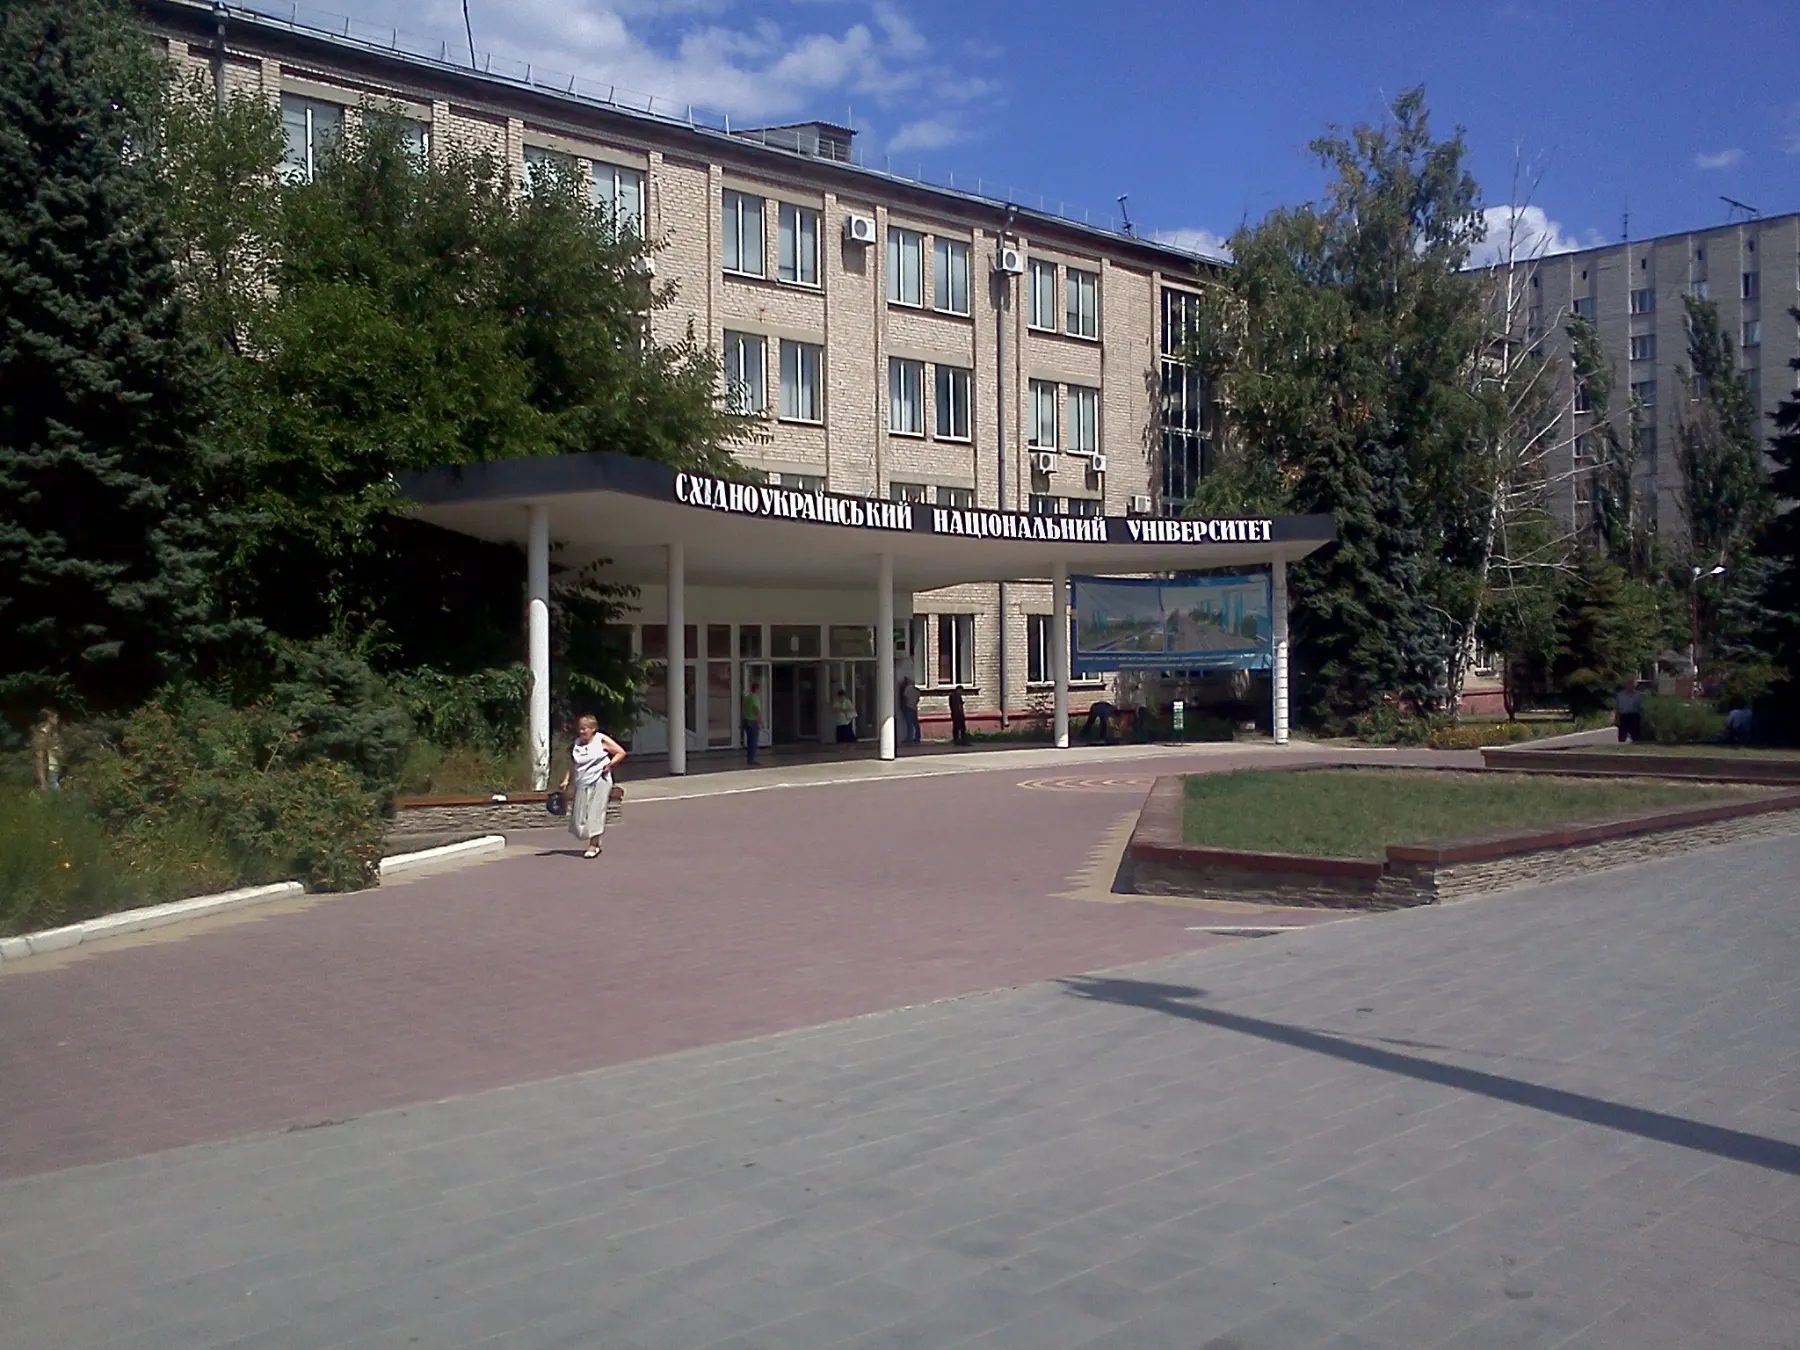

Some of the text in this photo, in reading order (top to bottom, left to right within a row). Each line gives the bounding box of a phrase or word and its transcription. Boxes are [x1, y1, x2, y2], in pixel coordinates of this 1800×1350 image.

[675, 473, 1273, 542] СХІДНОУКРАЇНСЬКИЙ НАЦІОНАЛЬНИЙ УНІВЕРСИТЕТ
